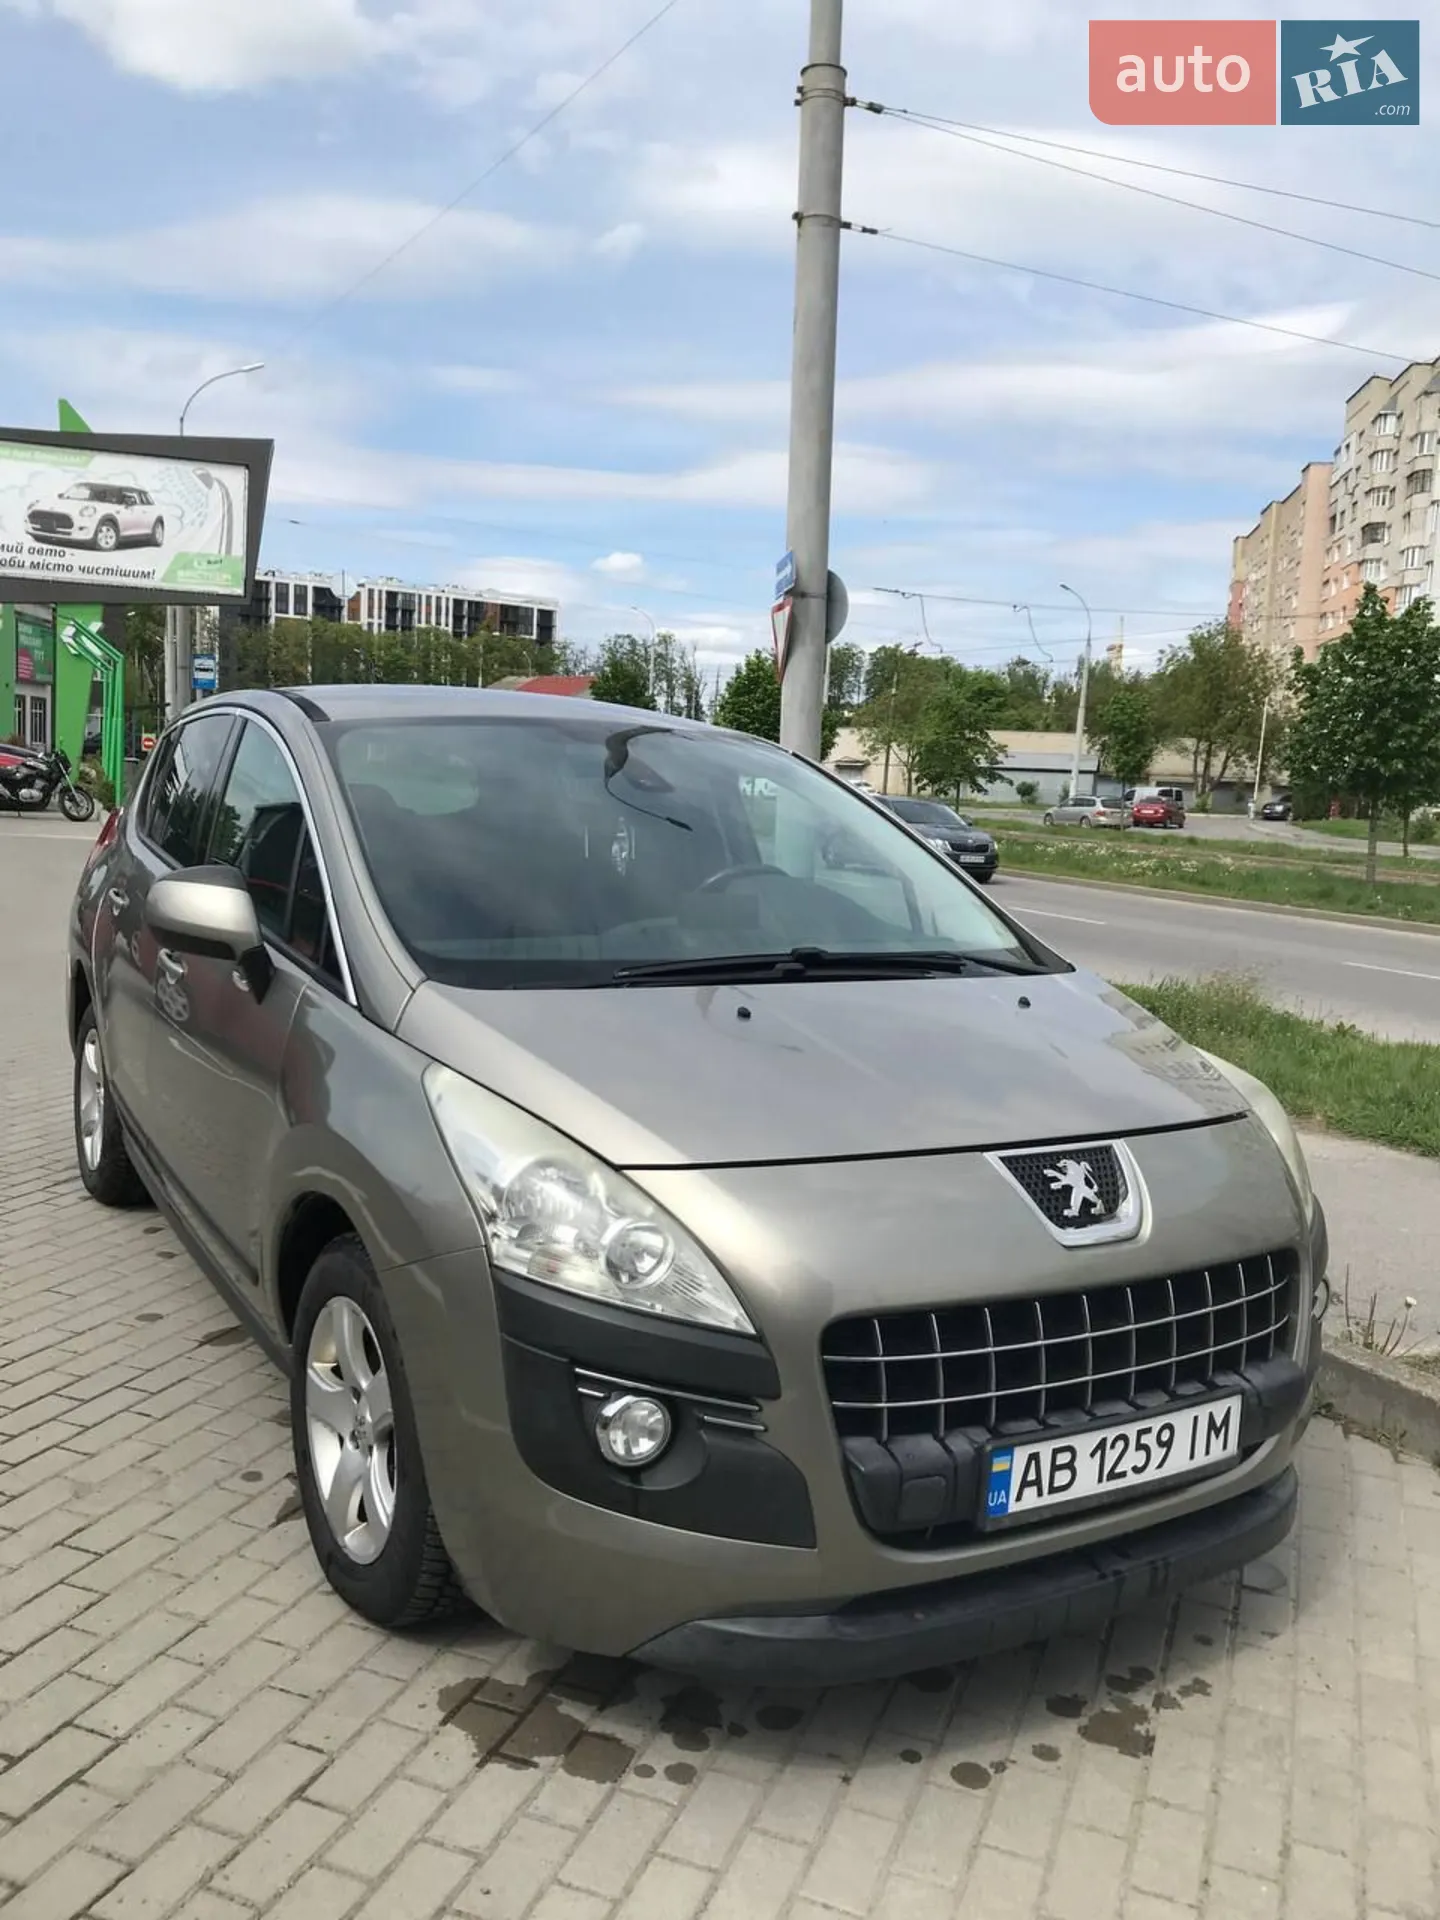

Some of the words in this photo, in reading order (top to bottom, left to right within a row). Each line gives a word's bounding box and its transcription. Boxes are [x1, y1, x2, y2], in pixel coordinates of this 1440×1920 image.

[28, 546, 66, 558] авто
[30, 559, 73, 573] місто
[78, 564, 156, 580] чистішим!
[1015, 1444, 1077, 1502] AB
[1089, 1422, 1175, 1484] 1259
[1189, 1406, 1232, 1461] IM
[988, 1490, 1007, 1507] UA
